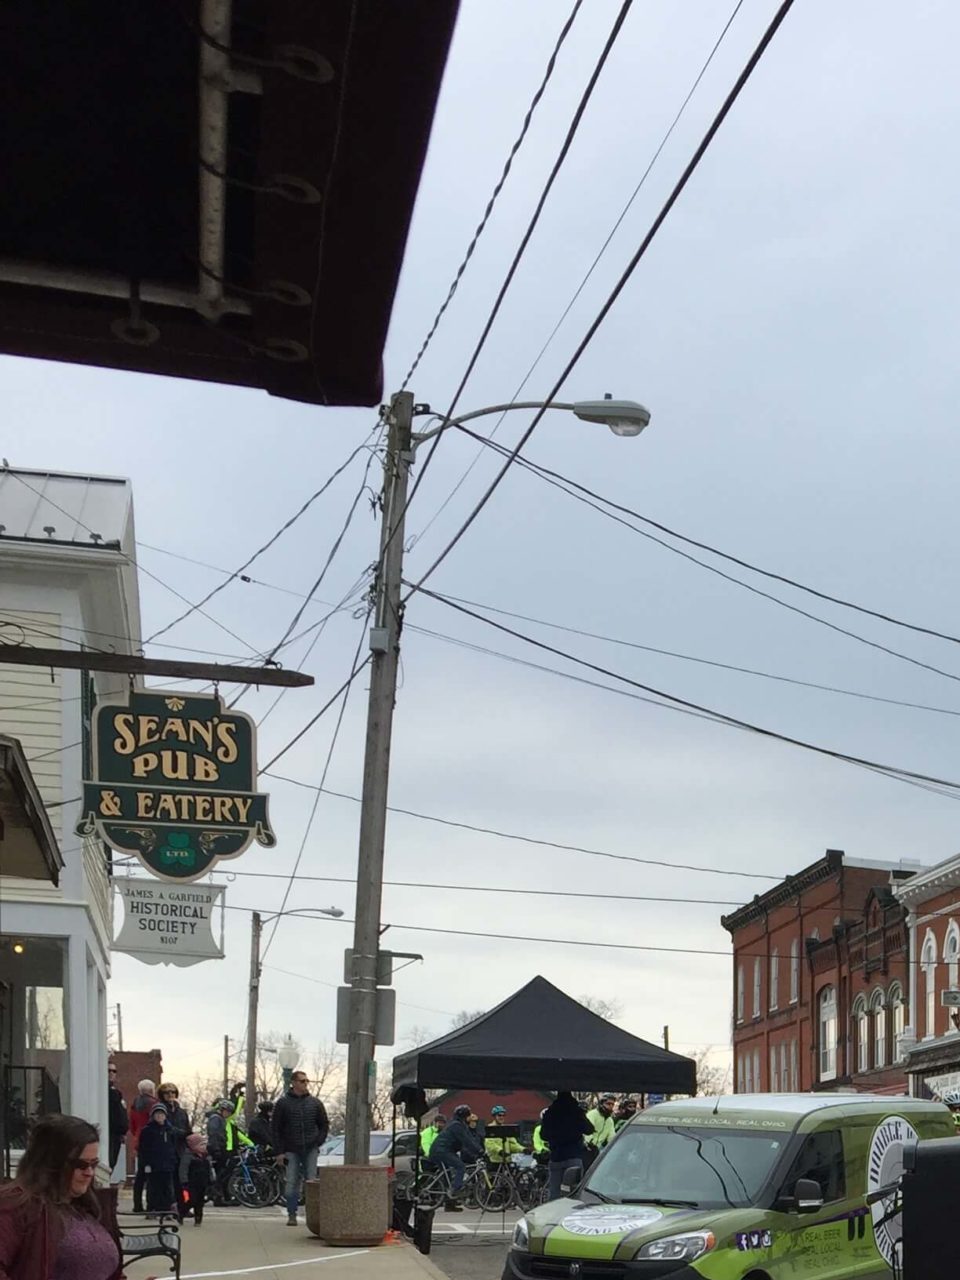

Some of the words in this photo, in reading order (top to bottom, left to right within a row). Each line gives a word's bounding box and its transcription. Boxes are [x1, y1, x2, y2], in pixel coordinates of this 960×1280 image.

[113, 713, 239, 764] SEAN'S
[132, 750, 220, 783] PUB
[100, 789, 123, 817] &
[137, 792, 252, 823] EATERY
[125, 888, 154, 900] JAMES
[168, 892, 212, 904] GARFIELD
[130, 901, 208, 920] HISTORICAL
[138, 918, 198, 935] SOCIETY
